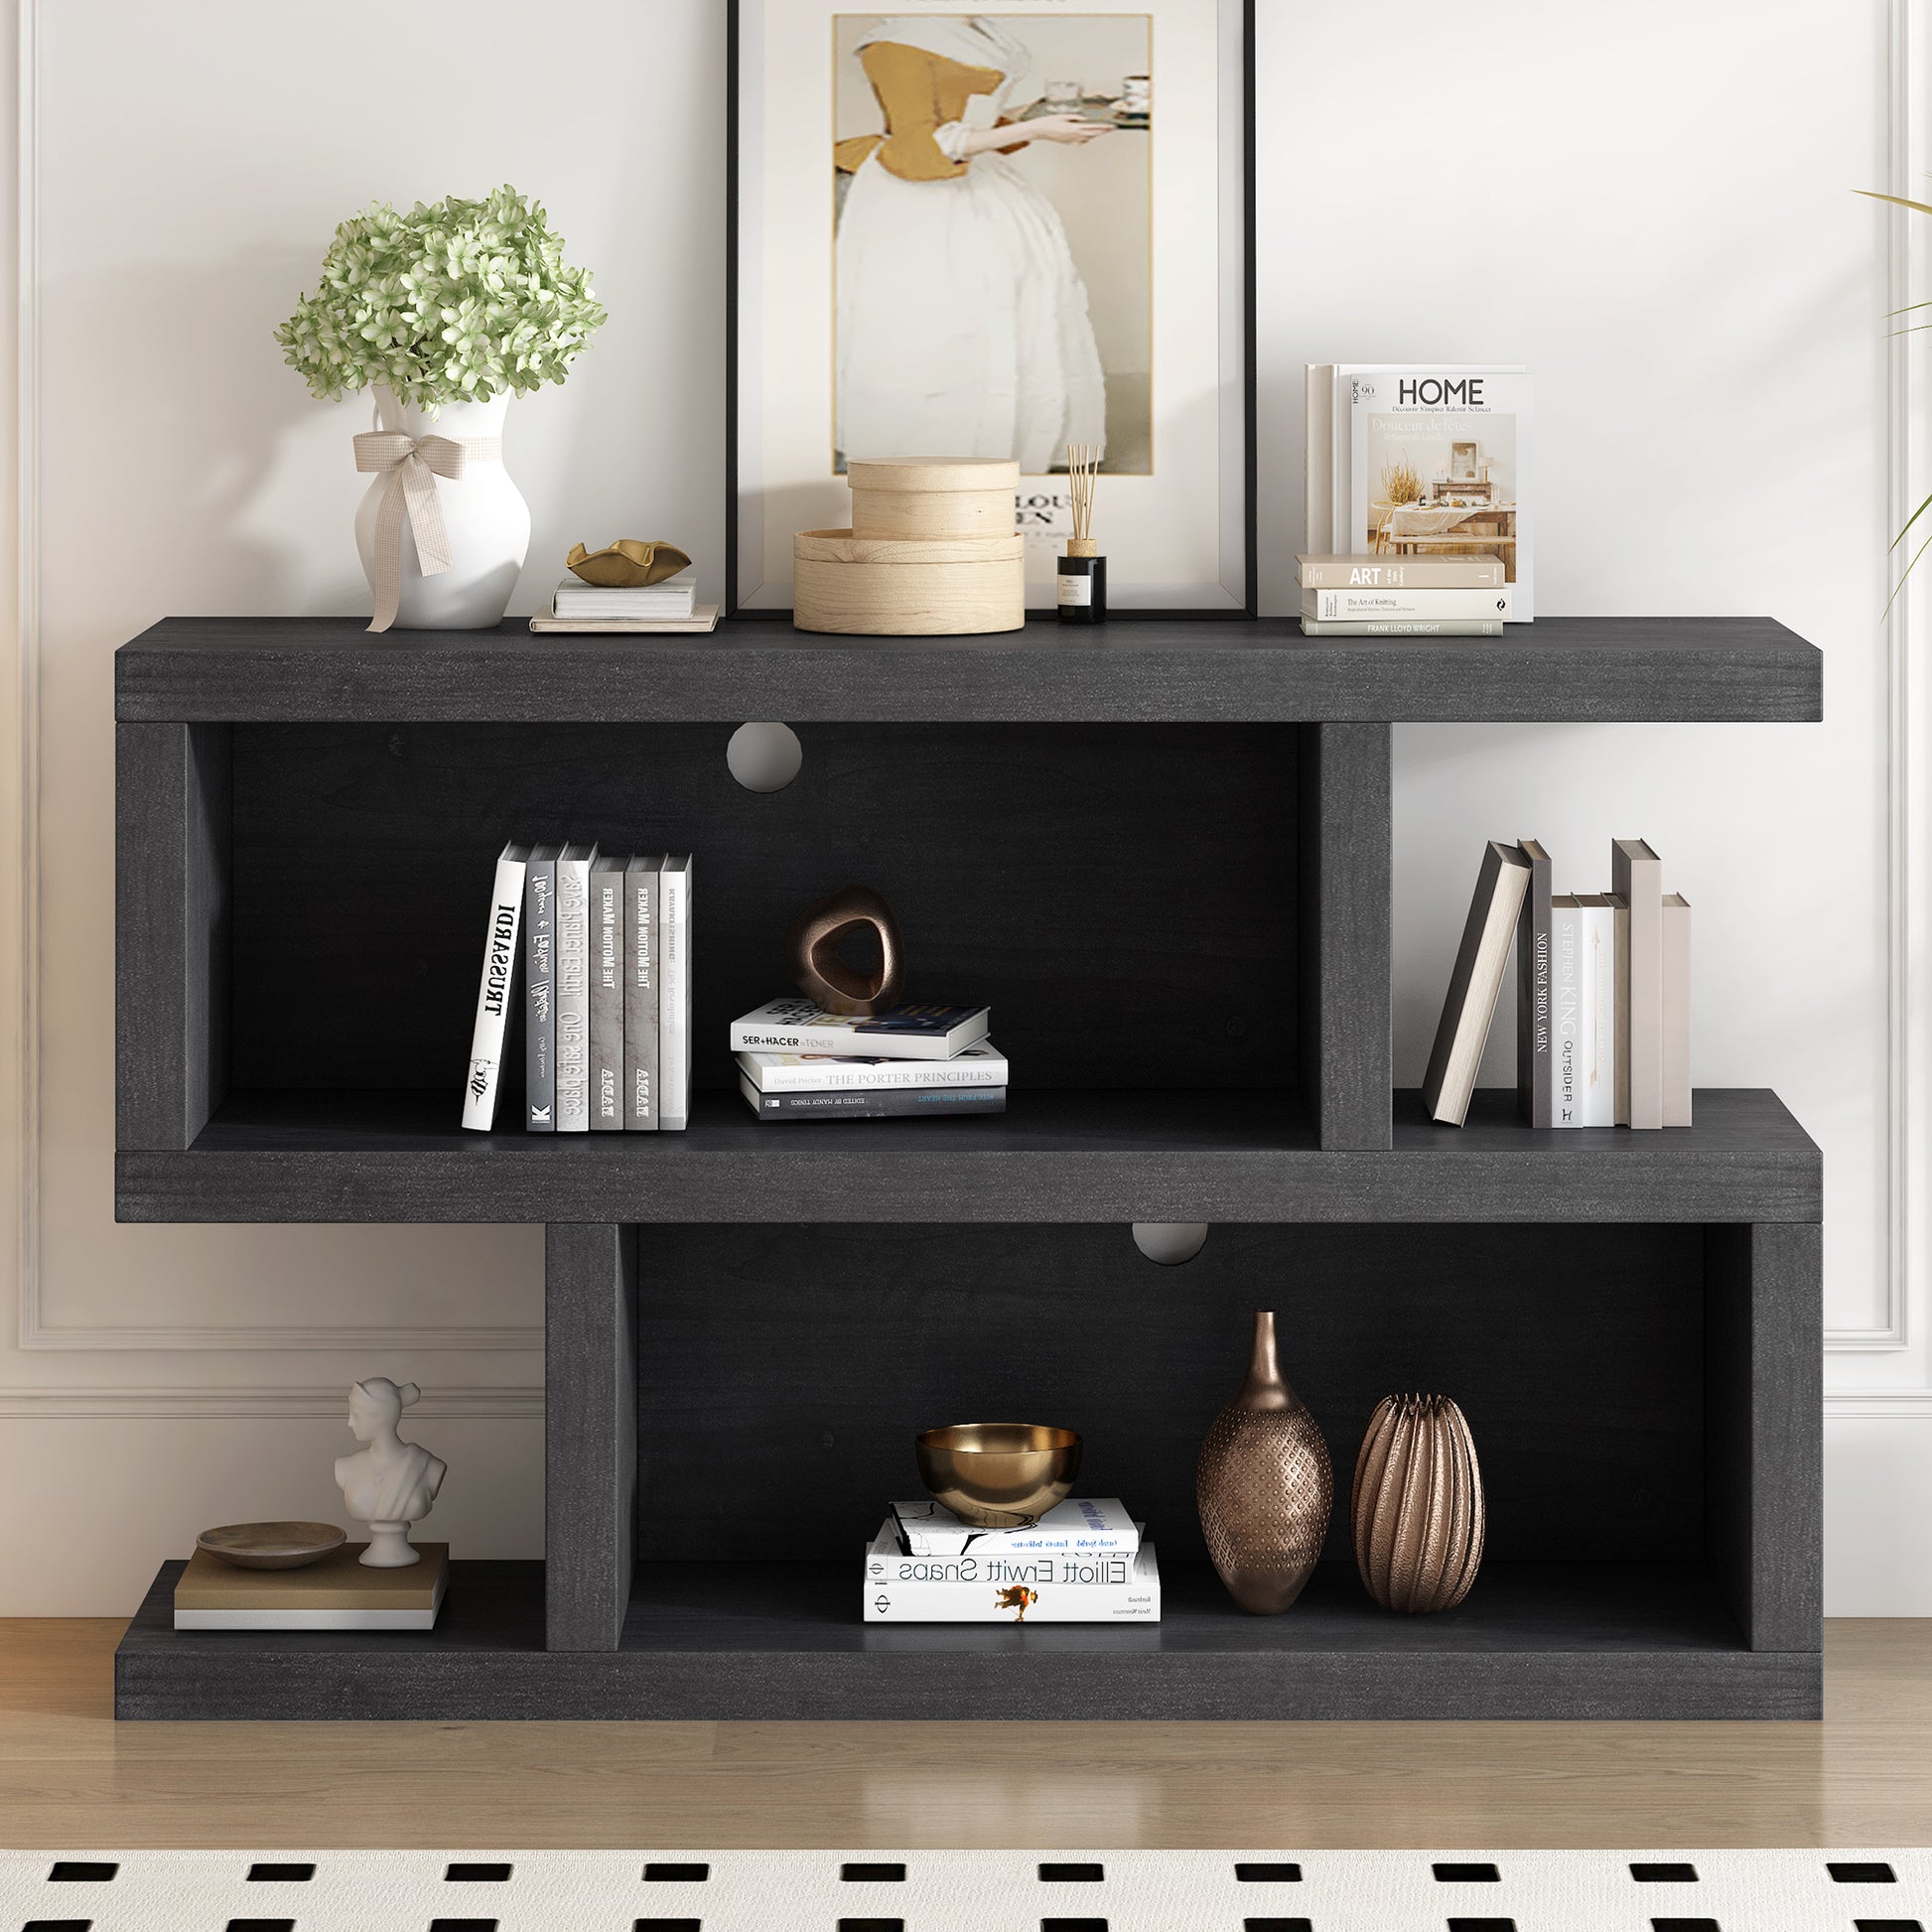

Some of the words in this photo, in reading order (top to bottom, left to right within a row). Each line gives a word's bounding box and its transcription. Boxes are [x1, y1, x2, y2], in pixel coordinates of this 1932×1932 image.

[1399, 378, 1484, 405] HOME
[1349, 567, 1381, 586] ART
[1367, 624, 1389, 633] FRANK
[1390, 624, 1412, 633] LLOYD
[1413, 624, 1440, 633] WRIGHT
[1537, 932, 1548, 987] FASHION
[1563, 923, 1574, 984] STEPHEN
[1537, 988, 1548, 1028] YORK
[1560, 985, 1577, 1035] KING
[1537, 1028, 1548, 1053] NEW
[773, 1076, 796, 1085] David
[797, 1076, 822, 1085] Porter
[826, 1075, 855, 1085] THE
[858, 1072, 910, 1085] PORTER
[914, 1070, 993, 1083] PRINCIPLES
[1563, 1040, 1574, 1103] OUTSIDER
